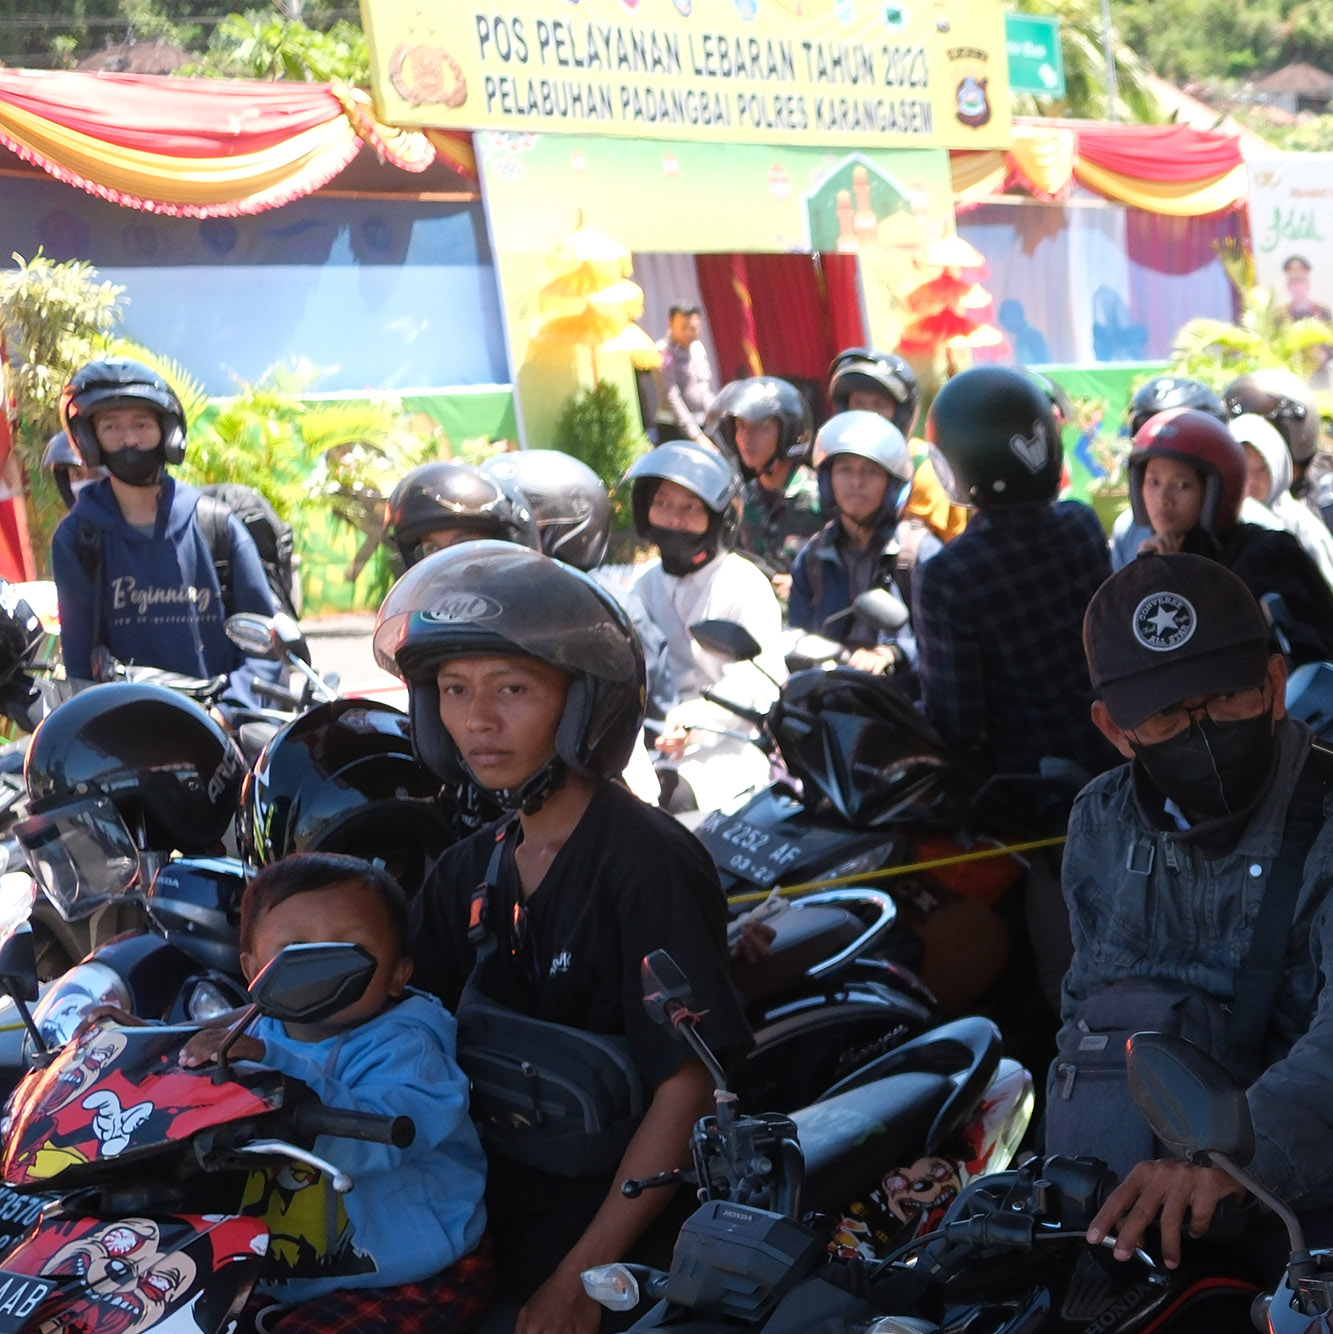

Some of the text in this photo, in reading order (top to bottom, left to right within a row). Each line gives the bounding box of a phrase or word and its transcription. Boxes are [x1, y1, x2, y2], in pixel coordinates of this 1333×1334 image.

[474, 14, 529, 64] POS
[536, 19, 683, 73] PELAYANAN
[686, 33, 796, 82] LEBARAN
[801, 41, 876, 85] TAHUN
[484, 75, 934, 133] PELABUHAN PADANGBAI POLRES KARANGASEM
[111, 575, 212, 615] Beginning
[1139, 596, 1184, 621] CONVERSE
[722, 821, 770, 852] 2252
[769, 842, 801, 865] AF
